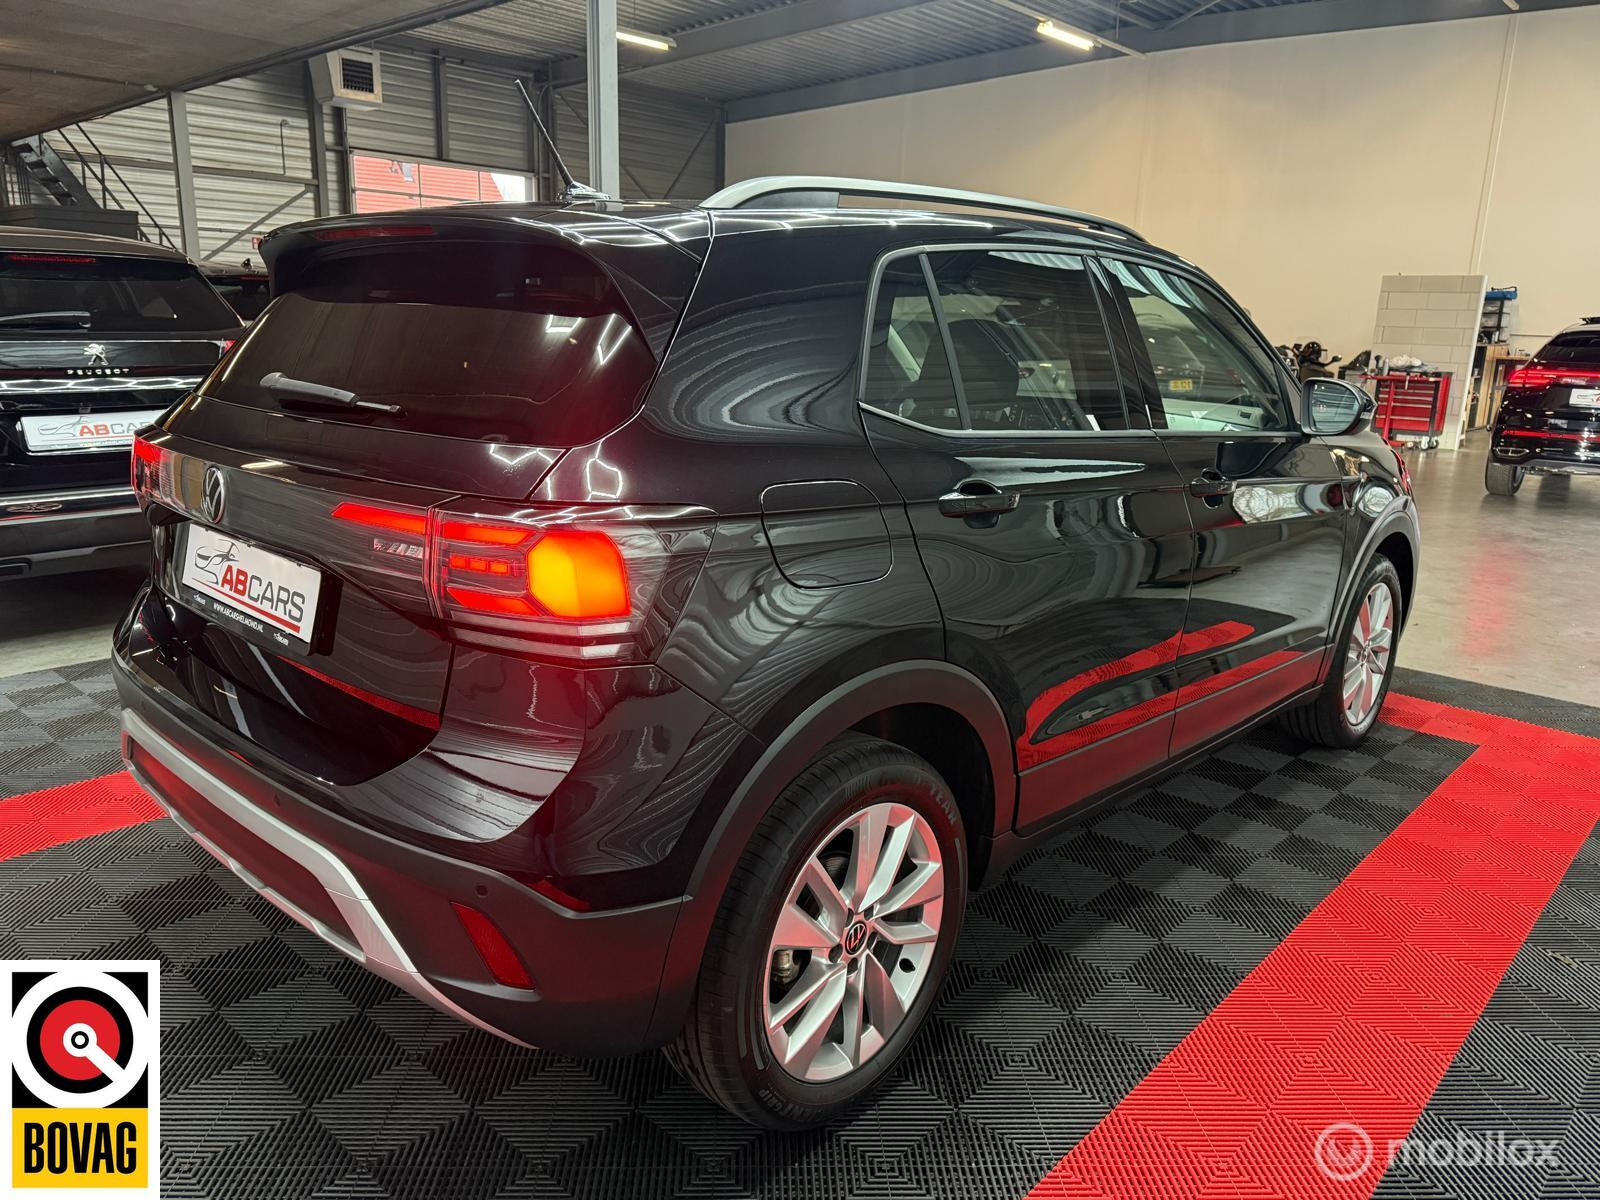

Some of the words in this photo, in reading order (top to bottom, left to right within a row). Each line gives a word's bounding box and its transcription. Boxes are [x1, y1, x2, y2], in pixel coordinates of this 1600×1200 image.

[67, 368, 130, 376] PEUGEOT
[79, 421, 153, 437] ABCA
[220, 564, 306, 623] ABCARS
